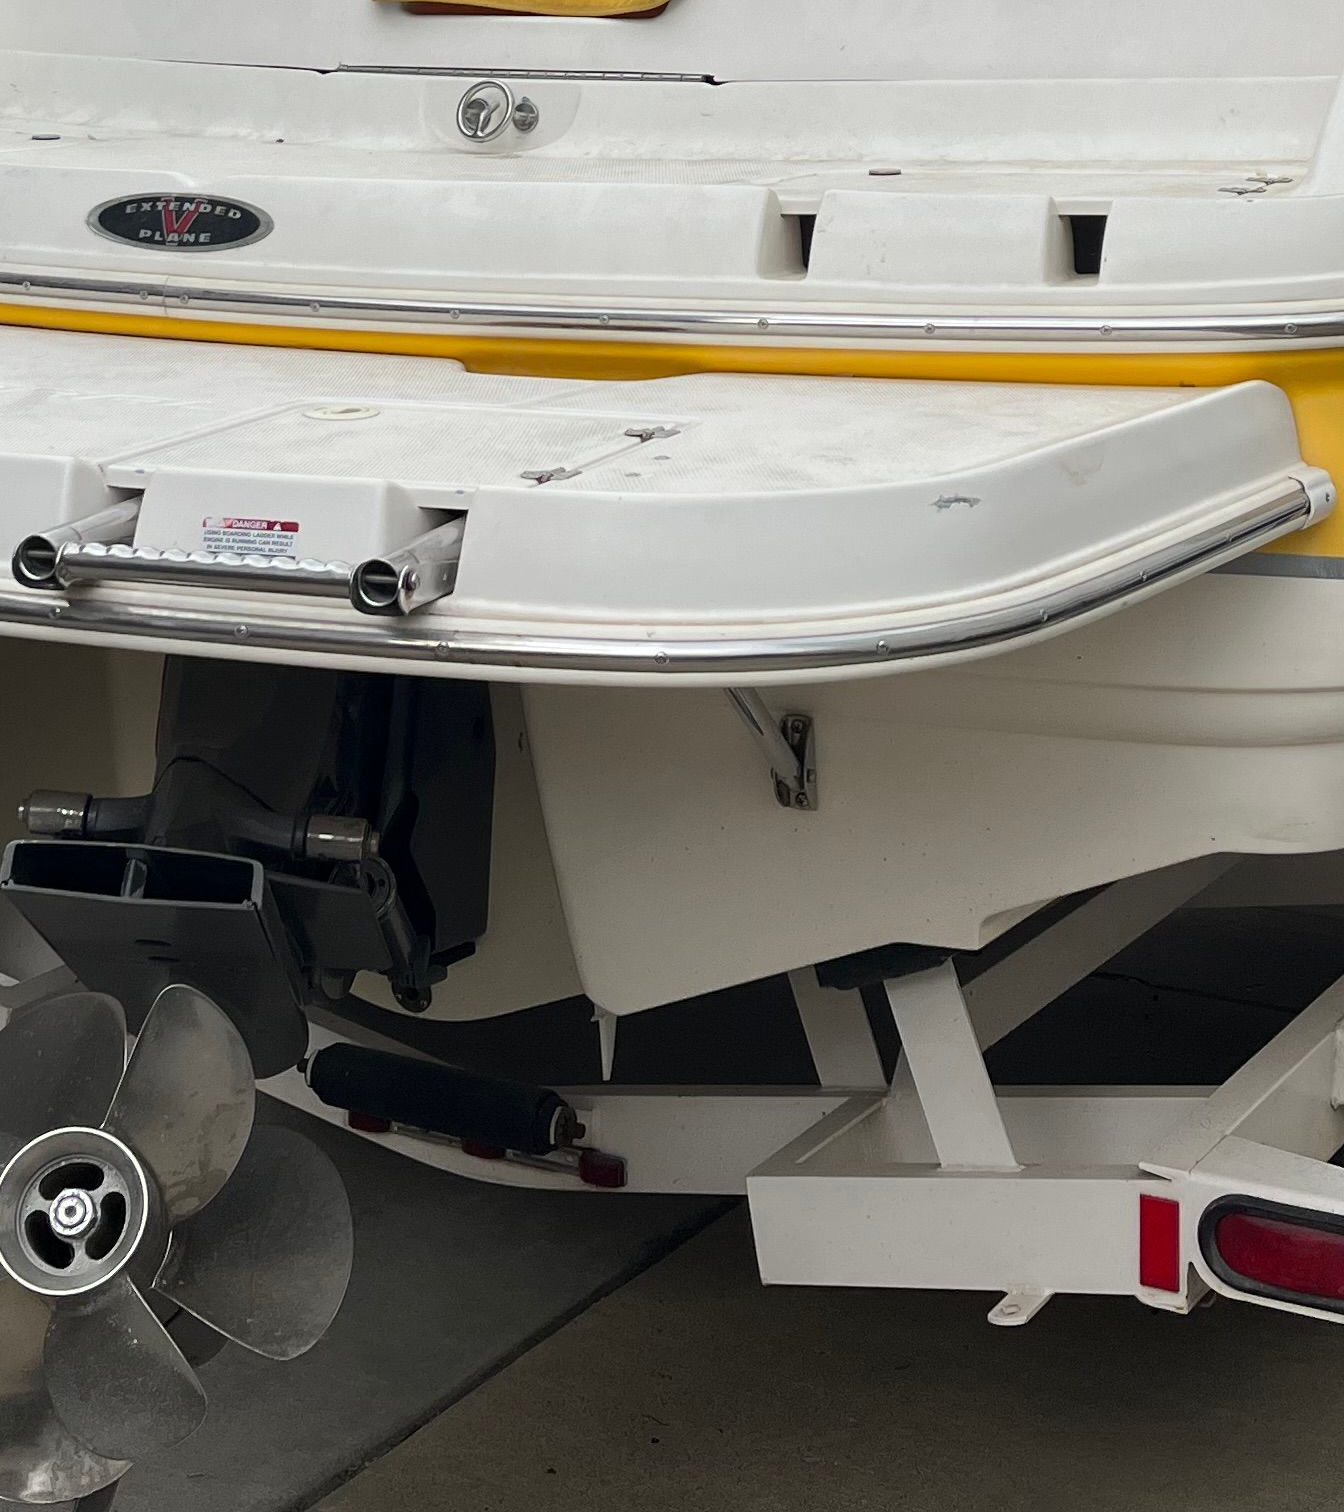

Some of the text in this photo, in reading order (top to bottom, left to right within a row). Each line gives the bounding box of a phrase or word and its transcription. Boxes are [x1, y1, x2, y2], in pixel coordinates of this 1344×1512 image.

[125, 201, 242, 219] EXTENDED
[139, 229, 212, 243] PLANE
[232, 520, 268, 529] DANGER
